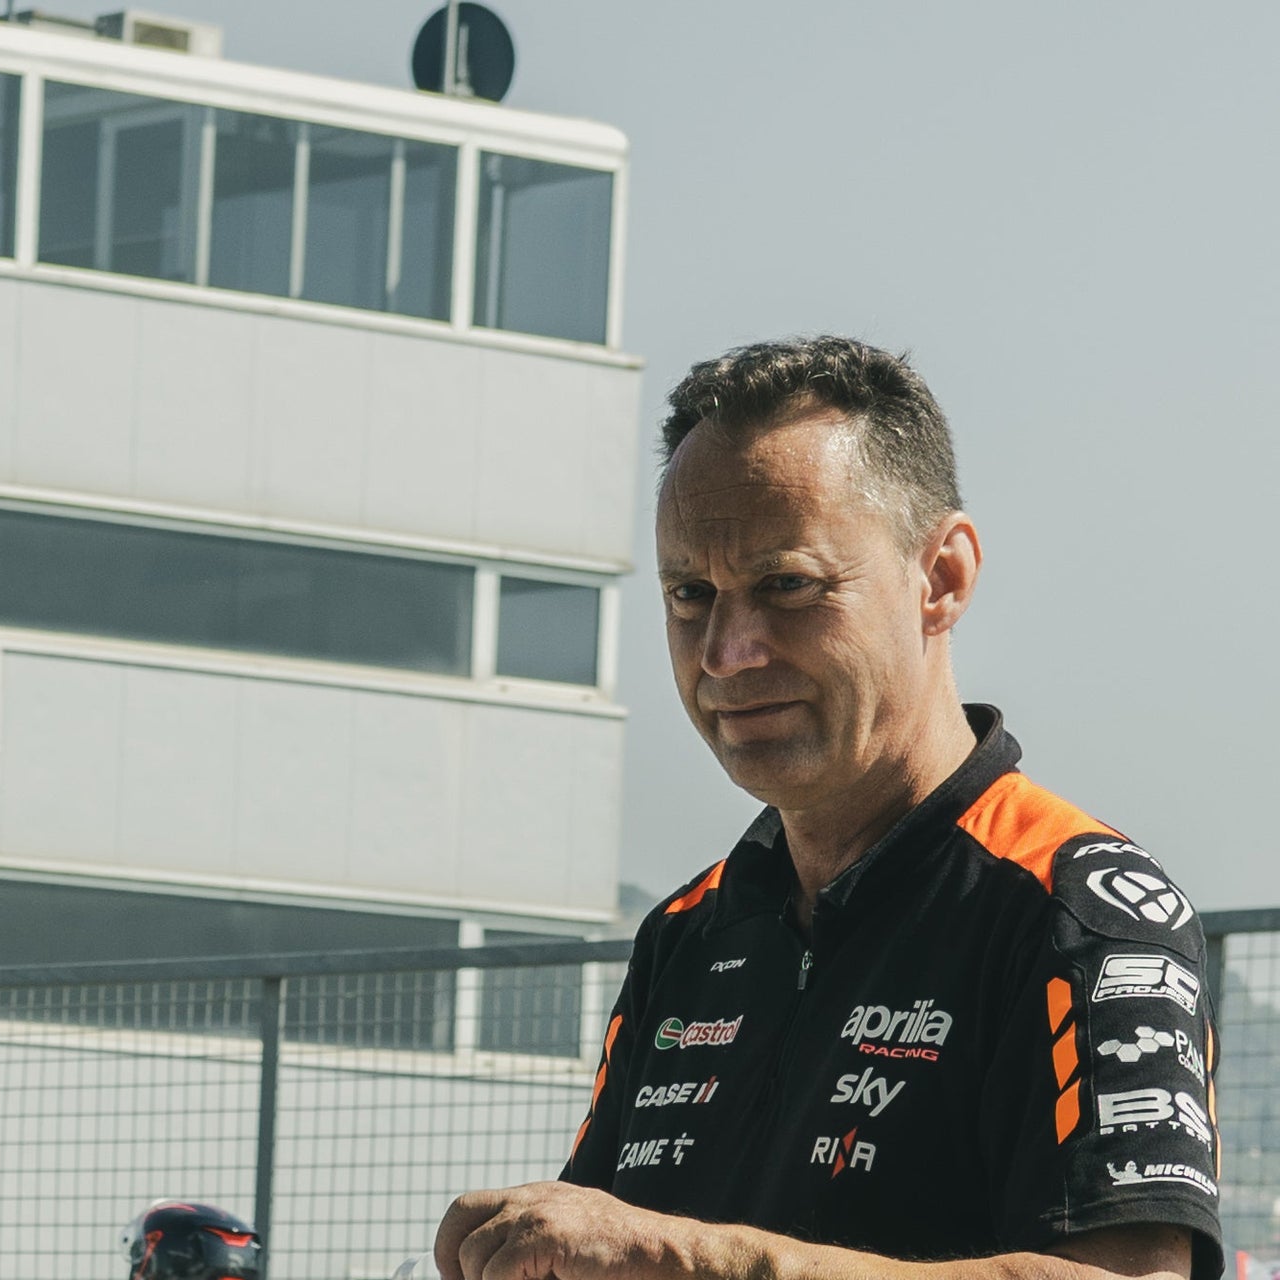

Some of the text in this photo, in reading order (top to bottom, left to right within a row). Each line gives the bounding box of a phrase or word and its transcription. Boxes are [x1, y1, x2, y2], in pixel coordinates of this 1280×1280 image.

[679, 1015, 744, 1049] Castrol
[840, 999, 954, 1047] aprilia
[858, 1043, 940, 1062] RACING
[635, 1082, 698, 1108] CASE
[830, 1066, 907, 1118] sky
[1098, 1088, 1212, 1142] BS
